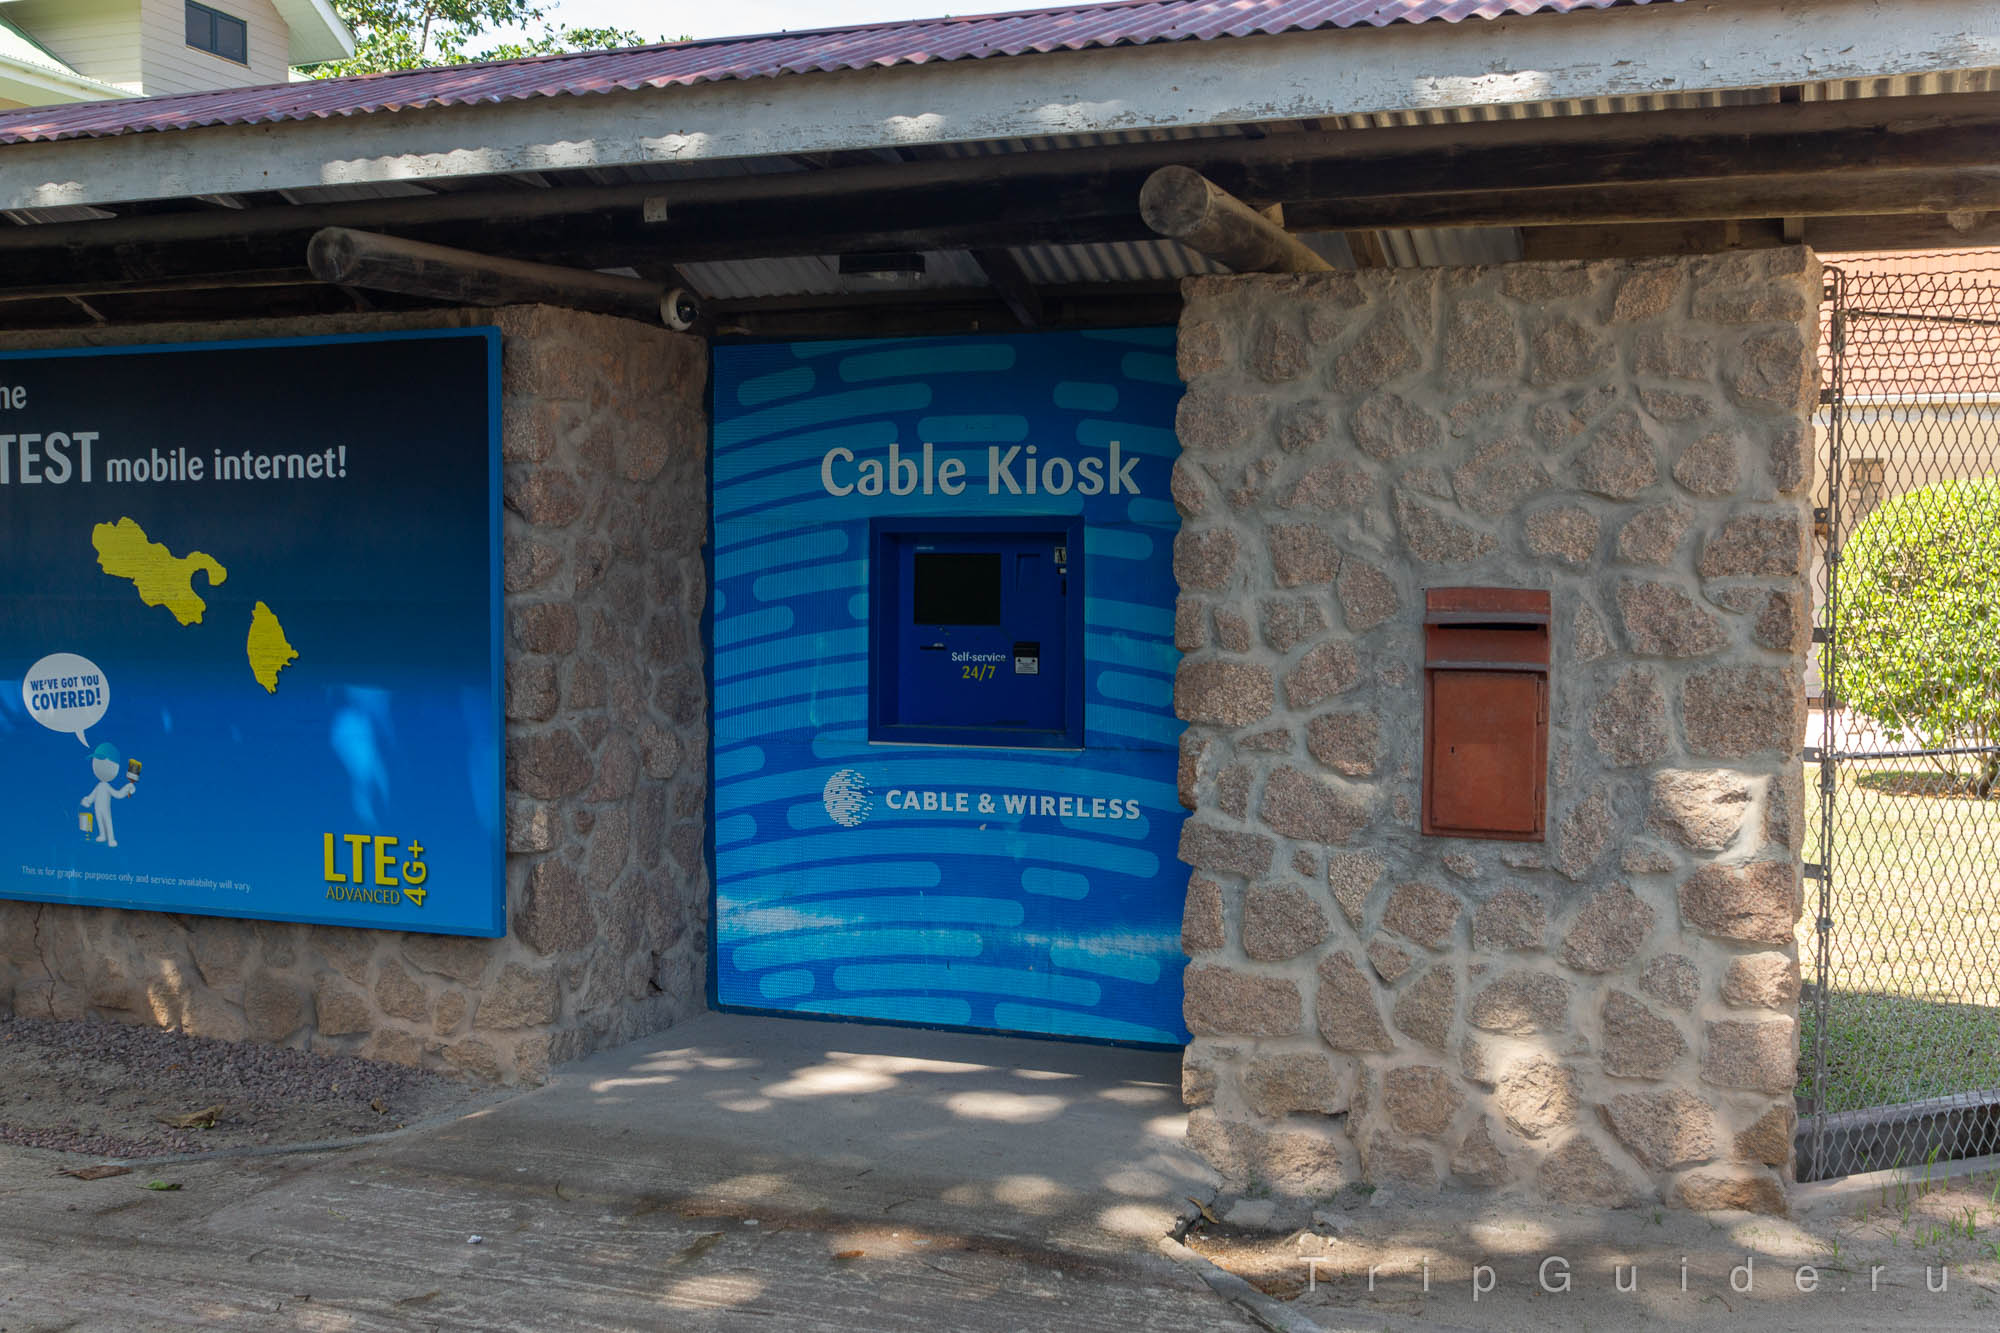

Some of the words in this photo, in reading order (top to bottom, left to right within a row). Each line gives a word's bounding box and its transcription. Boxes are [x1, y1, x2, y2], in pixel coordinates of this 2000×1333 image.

[0, 431, 100, 485] TEST
[106, 447, 204, 483] mobile
[214, 445, 347, 481] internet!
[821, 442, 967, 497] Cable
[988, 440, 1142, 496] Kiosk
[951, 651, 1007, 663] Self-service
[30, 678, 59, 692] WE'VE
[61, 676, 78, 689] GOT
[81, 674, 99, 687] YOU
[962, 664, 996, 681] 24/7
[32, 687, 102, 711] COVERED!
[885, 789, 970, 813] CABLE
[977, 792, 996, 815] &
[1003, 792, 1141, 821] WIRELESS
[323, 832, 399, 886] LTE
[22, 865, 36, 876] This
[45, 866, 56, 877] for
[57, 868, 83, 881] graphic
[84, 871, 118, 882] purposes
[118, 873, 134, 885] only
[136, 873, 149, 884] and
[150, 876, 176, 886] service
[178, 876, 217, 891] availability
[219, 879, 233, 889] will
[402, 839, 427, 907] 4G+
[325, 885, 401, 905] ADVANCED
